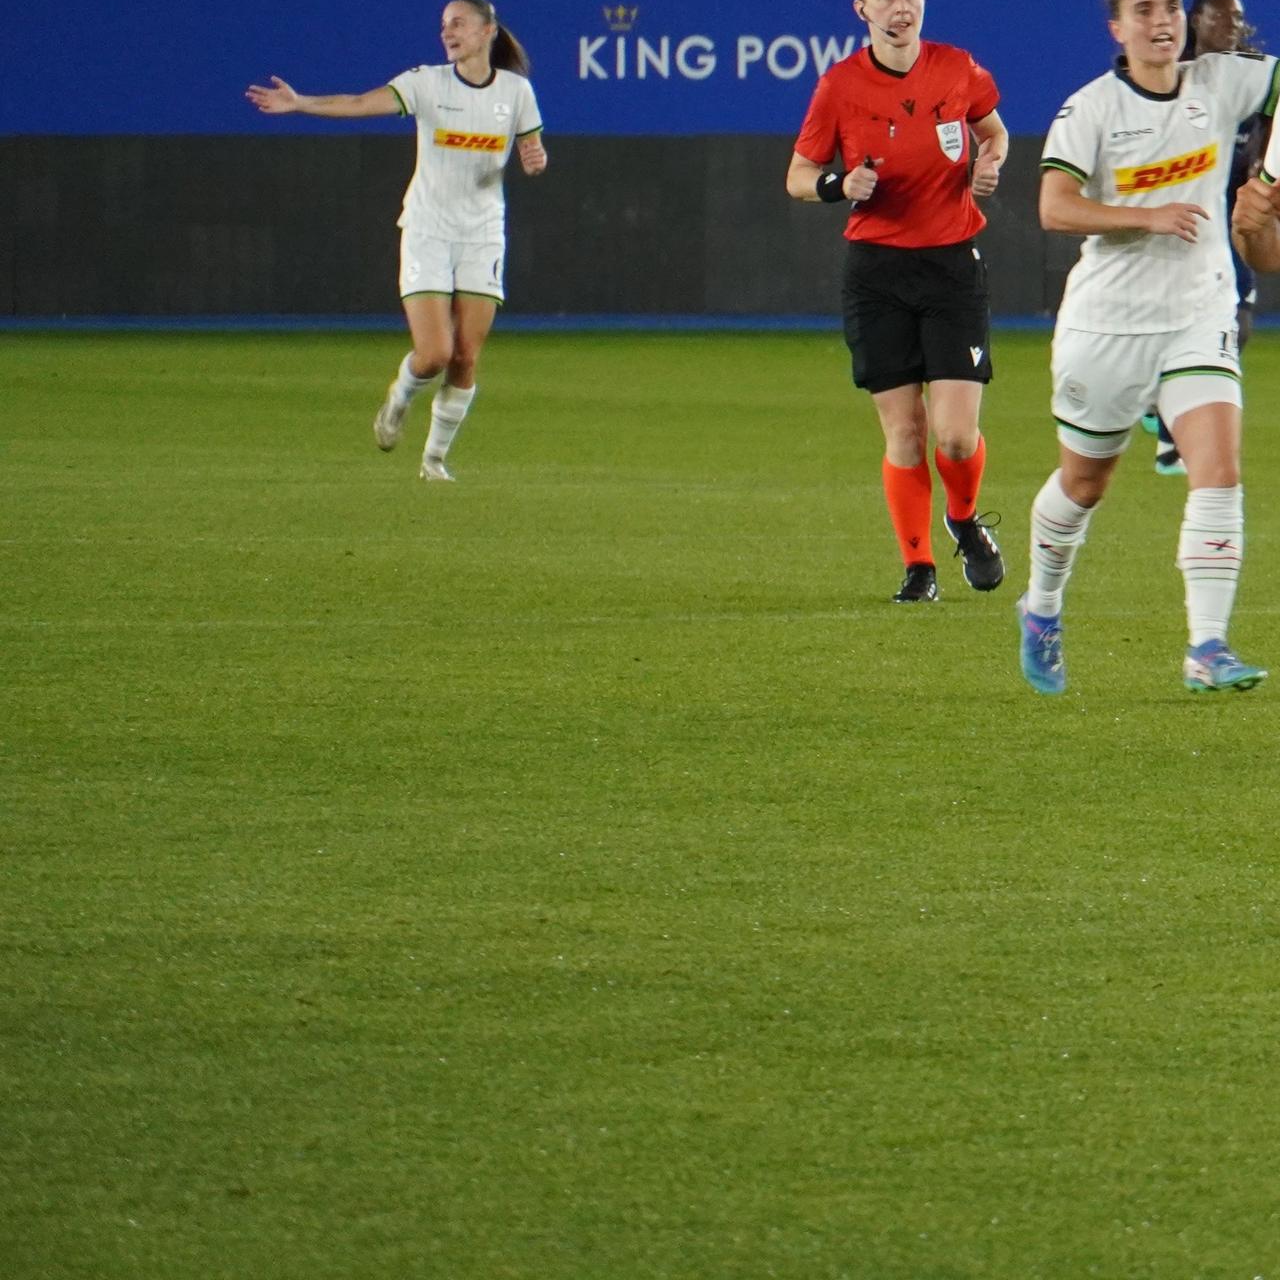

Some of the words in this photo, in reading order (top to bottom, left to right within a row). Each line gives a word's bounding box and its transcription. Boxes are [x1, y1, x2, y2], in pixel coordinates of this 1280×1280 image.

[578, 34, 717, 80] KING
[736, 34, 870, 79] POW
[445, 134, 498, 149] DHL
[1132, 151, 1213, 190] DHL
